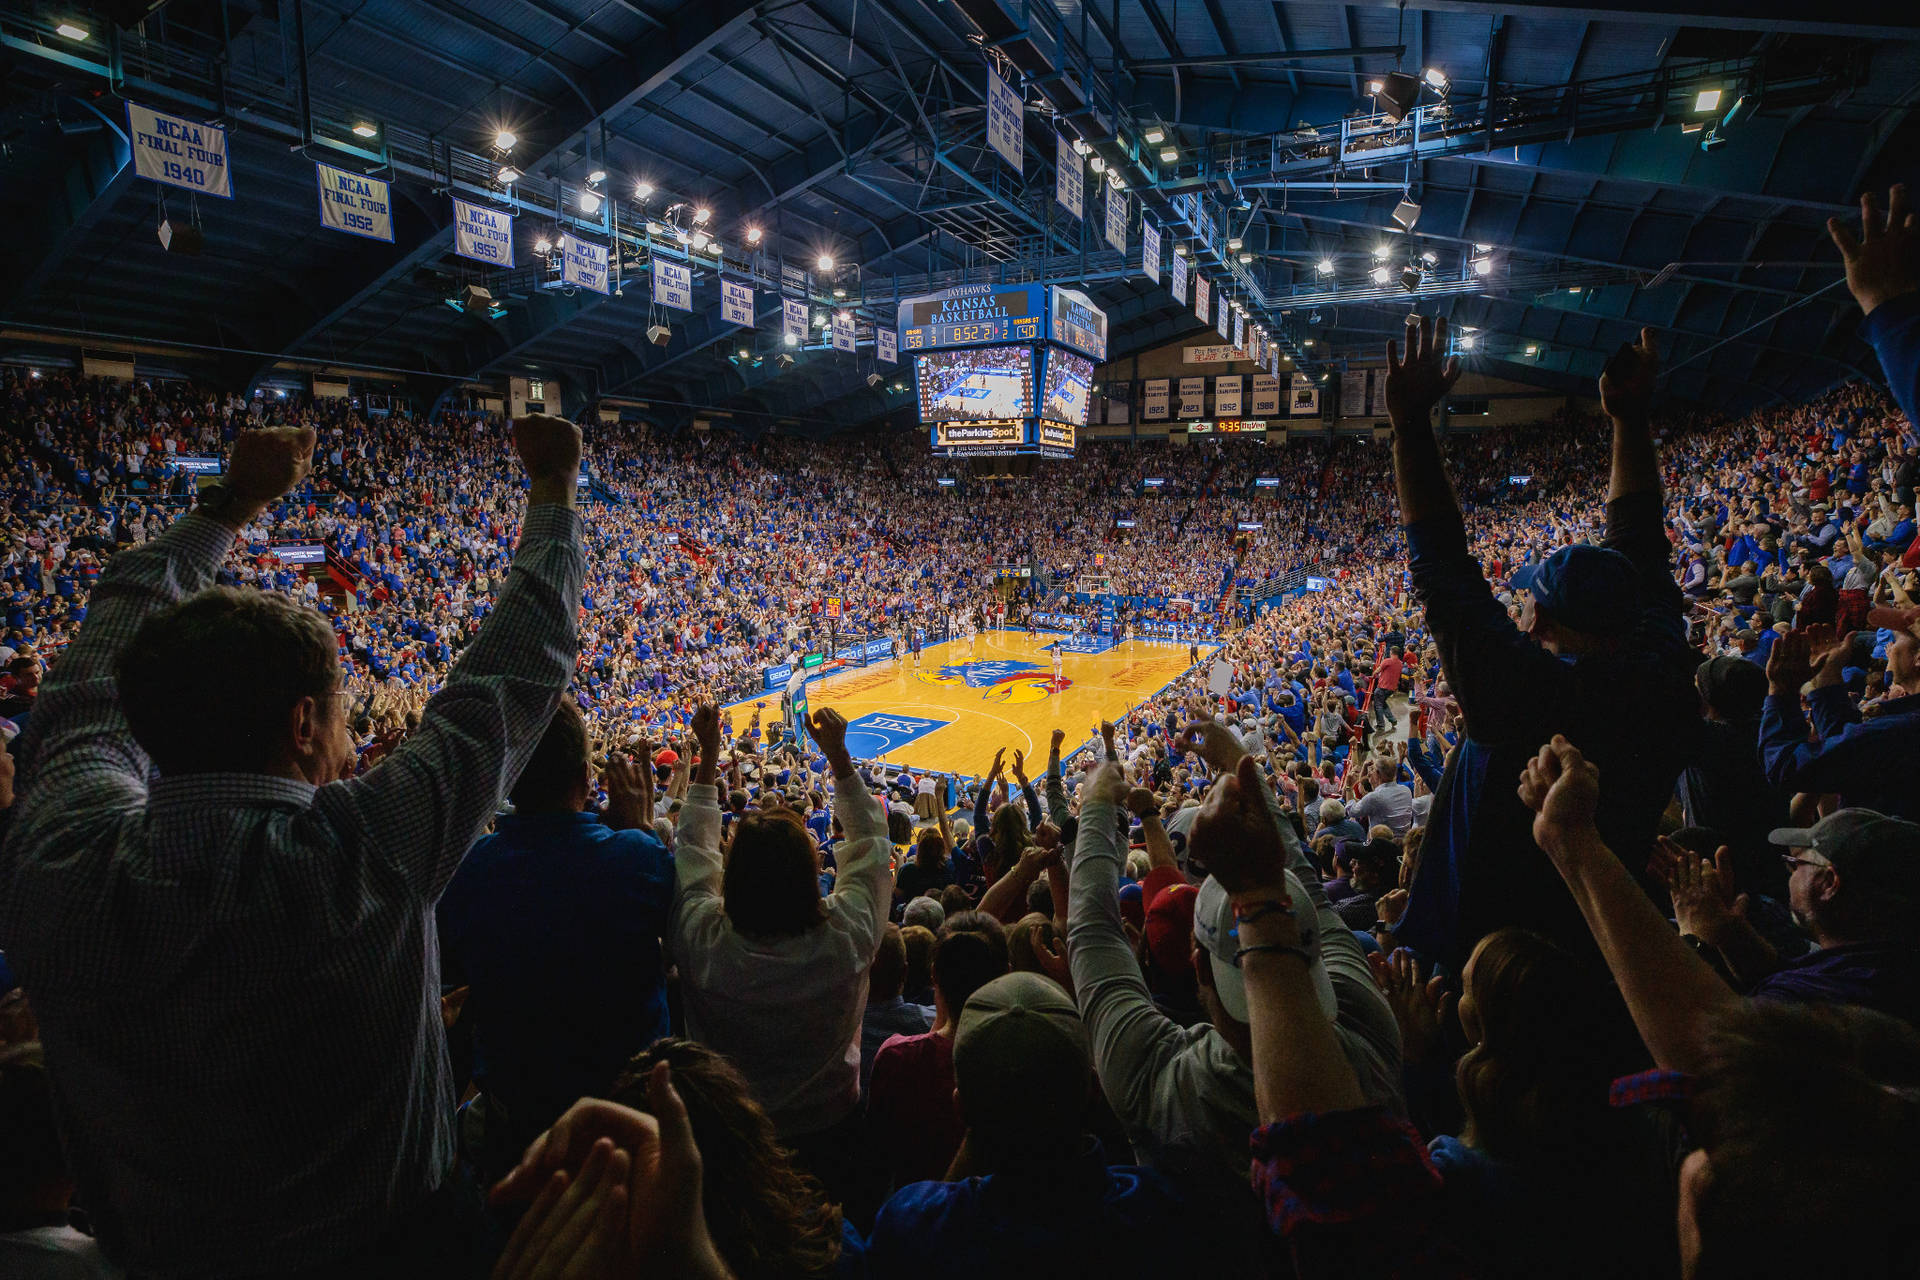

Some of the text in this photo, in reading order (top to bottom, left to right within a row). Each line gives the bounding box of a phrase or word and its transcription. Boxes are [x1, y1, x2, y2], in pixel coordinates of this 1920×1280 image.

[990, 89, 1022, 131] CHAMPIONS
[155, 117, 203, 146] NCAA
[137, 131, 223, 167] FINAL FOUR
[163, 160, 204, 186] 1940
[337, 175, 372, 198] NCAA
[325, 188, 387, 215] FINAL FOUR
[343, 211, 373, 232] 1952
[470, 209, 497, 228] NCAA
[460, 220, 509, 244] FINAL FOUR
[473, 241, 498, 259] 1953
[576, 242, 597, 260] NCAA
[567, 252, 607, 273] FINAL FOUR
[578, 270, 597, 289] 1957
[664, 266, 683, 281] NCAA
[947, 284, 992, 299] JAYHAWKS
[942, 295, 996, 312] KANSAS
[931, 306, 1009, 324] BASKETBALL
[983, 328, 991, 340] 2
[1002, 329, 1009, 340] 2
[1021, 325, 1035, 338] 40
[931, 336, 937, 346] 3
[1233, 350, 1246, 359] THE
[1149, 406, 1165, 414] 1922
[1220, 403, 1237, 412] 1952
[1256, 402, 1274, 410] 1988
[1219, 420, 1240, 432] 9:35
[769, 669, 791, 680] GEICO
